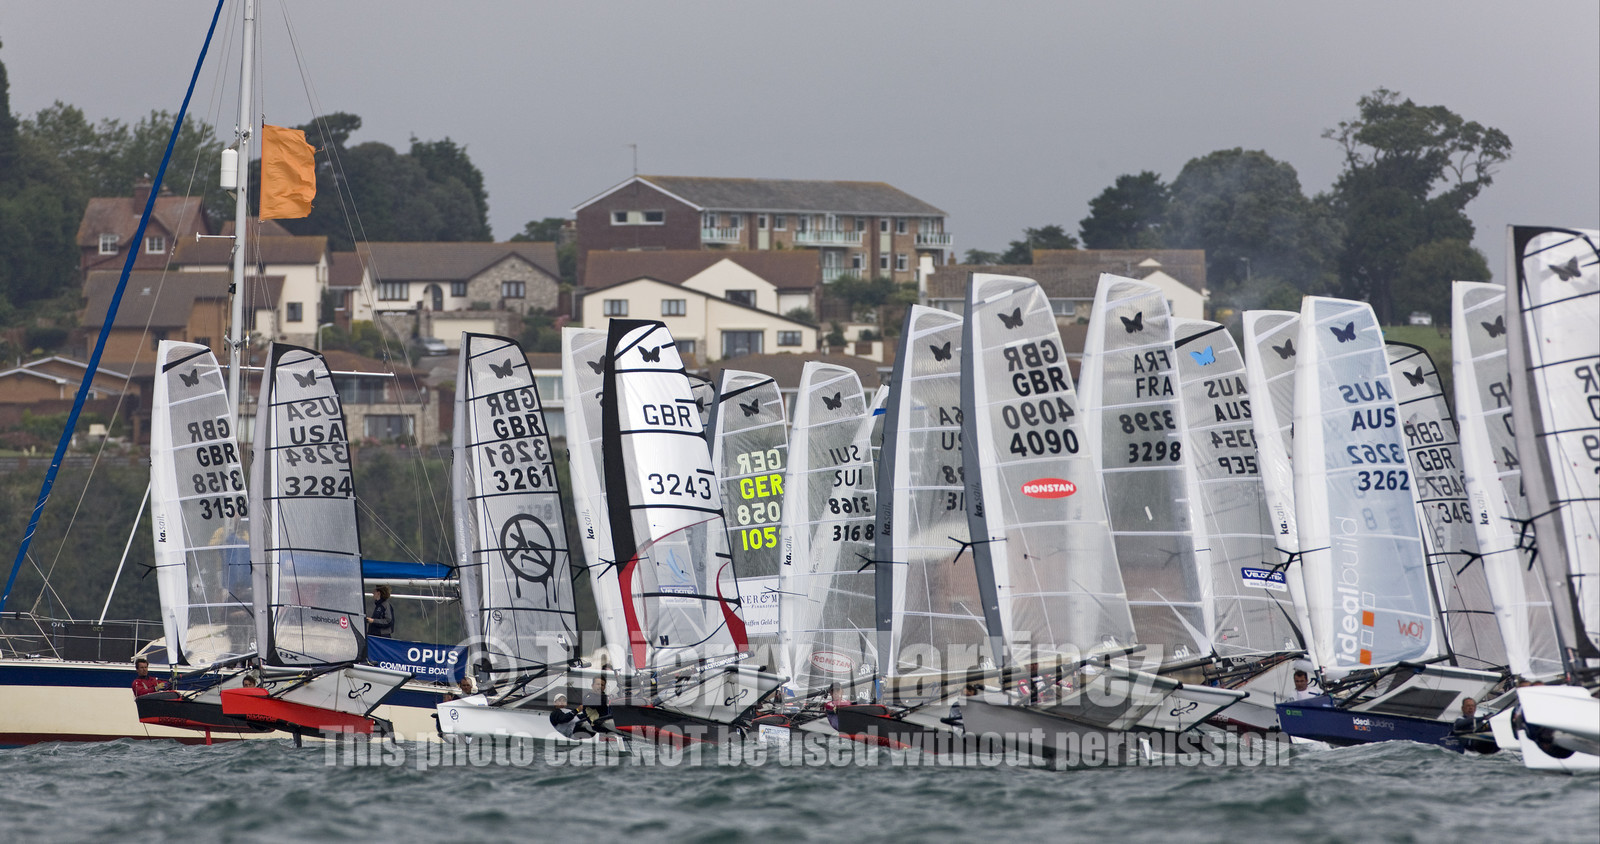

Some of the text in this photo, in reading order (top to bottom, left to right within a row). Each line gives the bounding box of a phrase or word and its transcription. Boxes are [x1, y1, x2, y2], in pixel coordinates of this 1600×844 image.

[1012, 366, 1069, 397] GBR
[1136, 376, 1174, 398] FRA
[493, 414, 543, 440] GBR
[643, 404, 692, 428] GBR
[1351, 407, 1396, 431] AUS
[290, 423, 343, 445] USA
[1010, 428, 1080, 457] 4090
[196, 443, 238, 467] GBR
[1128, 441, 1181, 463] 3298
[1416, 447, 1456, 472] GBR
[1218, 456, 1258, 474] 935
[285, 476, 353, 497] 3284
[493, 466, 553, 492] 3261
[648, 473, 712, 500] 3243
[740, 474, 784, 499] GER
[834, 468, 863, 487] SUI
[1023, 483, 1074, 494] RONSTAN
[1358, 470, 1409, 491] 3262
[200, 496, 248, 520] 3158
[1438, 502, 1472, 523] 346
[742, 527, 781, 551] 105
[833, 524, 875, 542] 3168
[407, 648, 459, 664] OPUS
[379, 661, 449, 676] COMMITTEE BOAT
